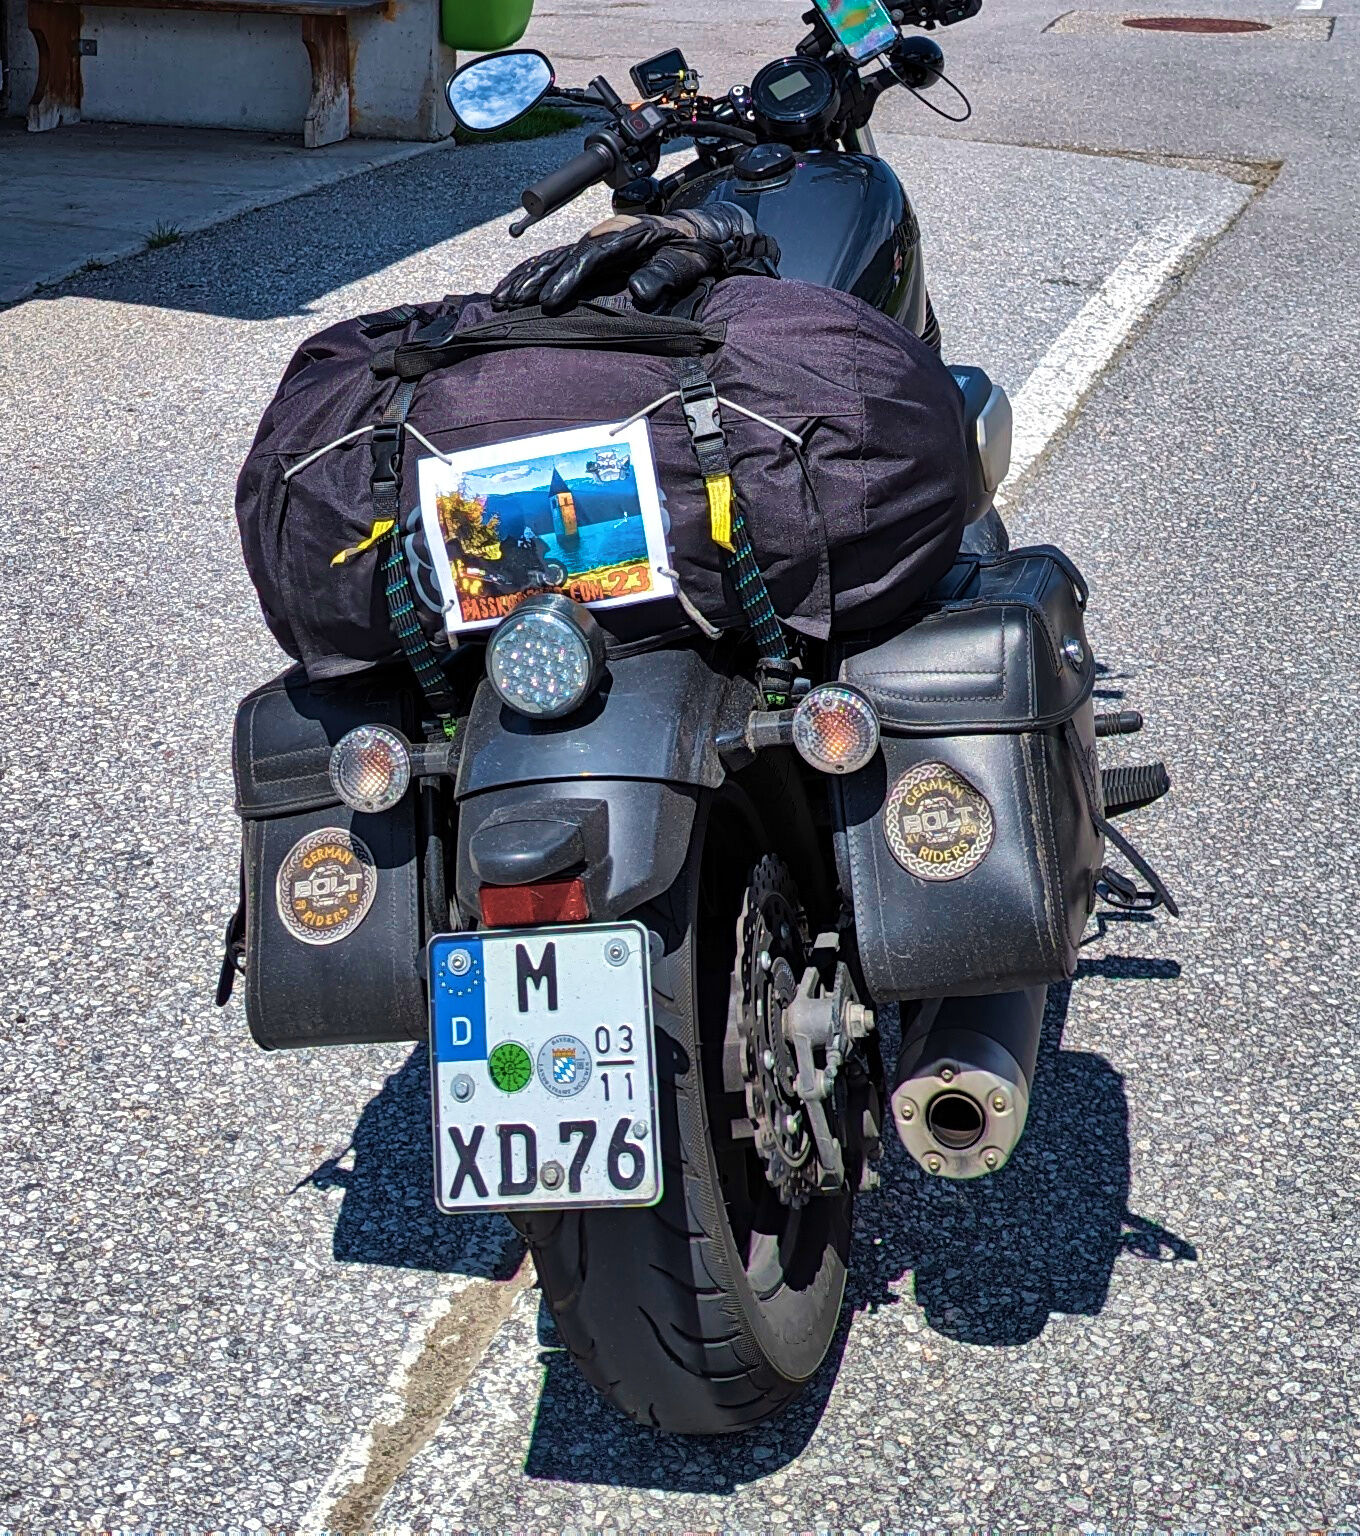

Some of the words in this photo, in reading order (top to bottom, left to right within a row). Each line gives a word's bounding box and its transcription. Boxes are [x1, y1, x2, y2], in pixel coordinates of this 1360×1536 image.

[905, 778, 966, 807] GERMAN
[902, 807, 974, 834] BOLT
[906, 834, 921, 844] XV
[960, 825, 977, 835] 950
[302, 846, 353, 869] GERMAN
[918, 839, 970, 863] RIDERS
[294, 873, 362, 898] BOLT
[302, 907, 349, 927] RIDERS
[515, 941, 558, 1013] M
[452, 1016, 472, 1046] D
[595, 1024, 634, 1054] 03
[601, 1072, 634, 1101] 11
[448, 1123, 538, 1199] XD
[559, 1117, 646, 1194] 76
